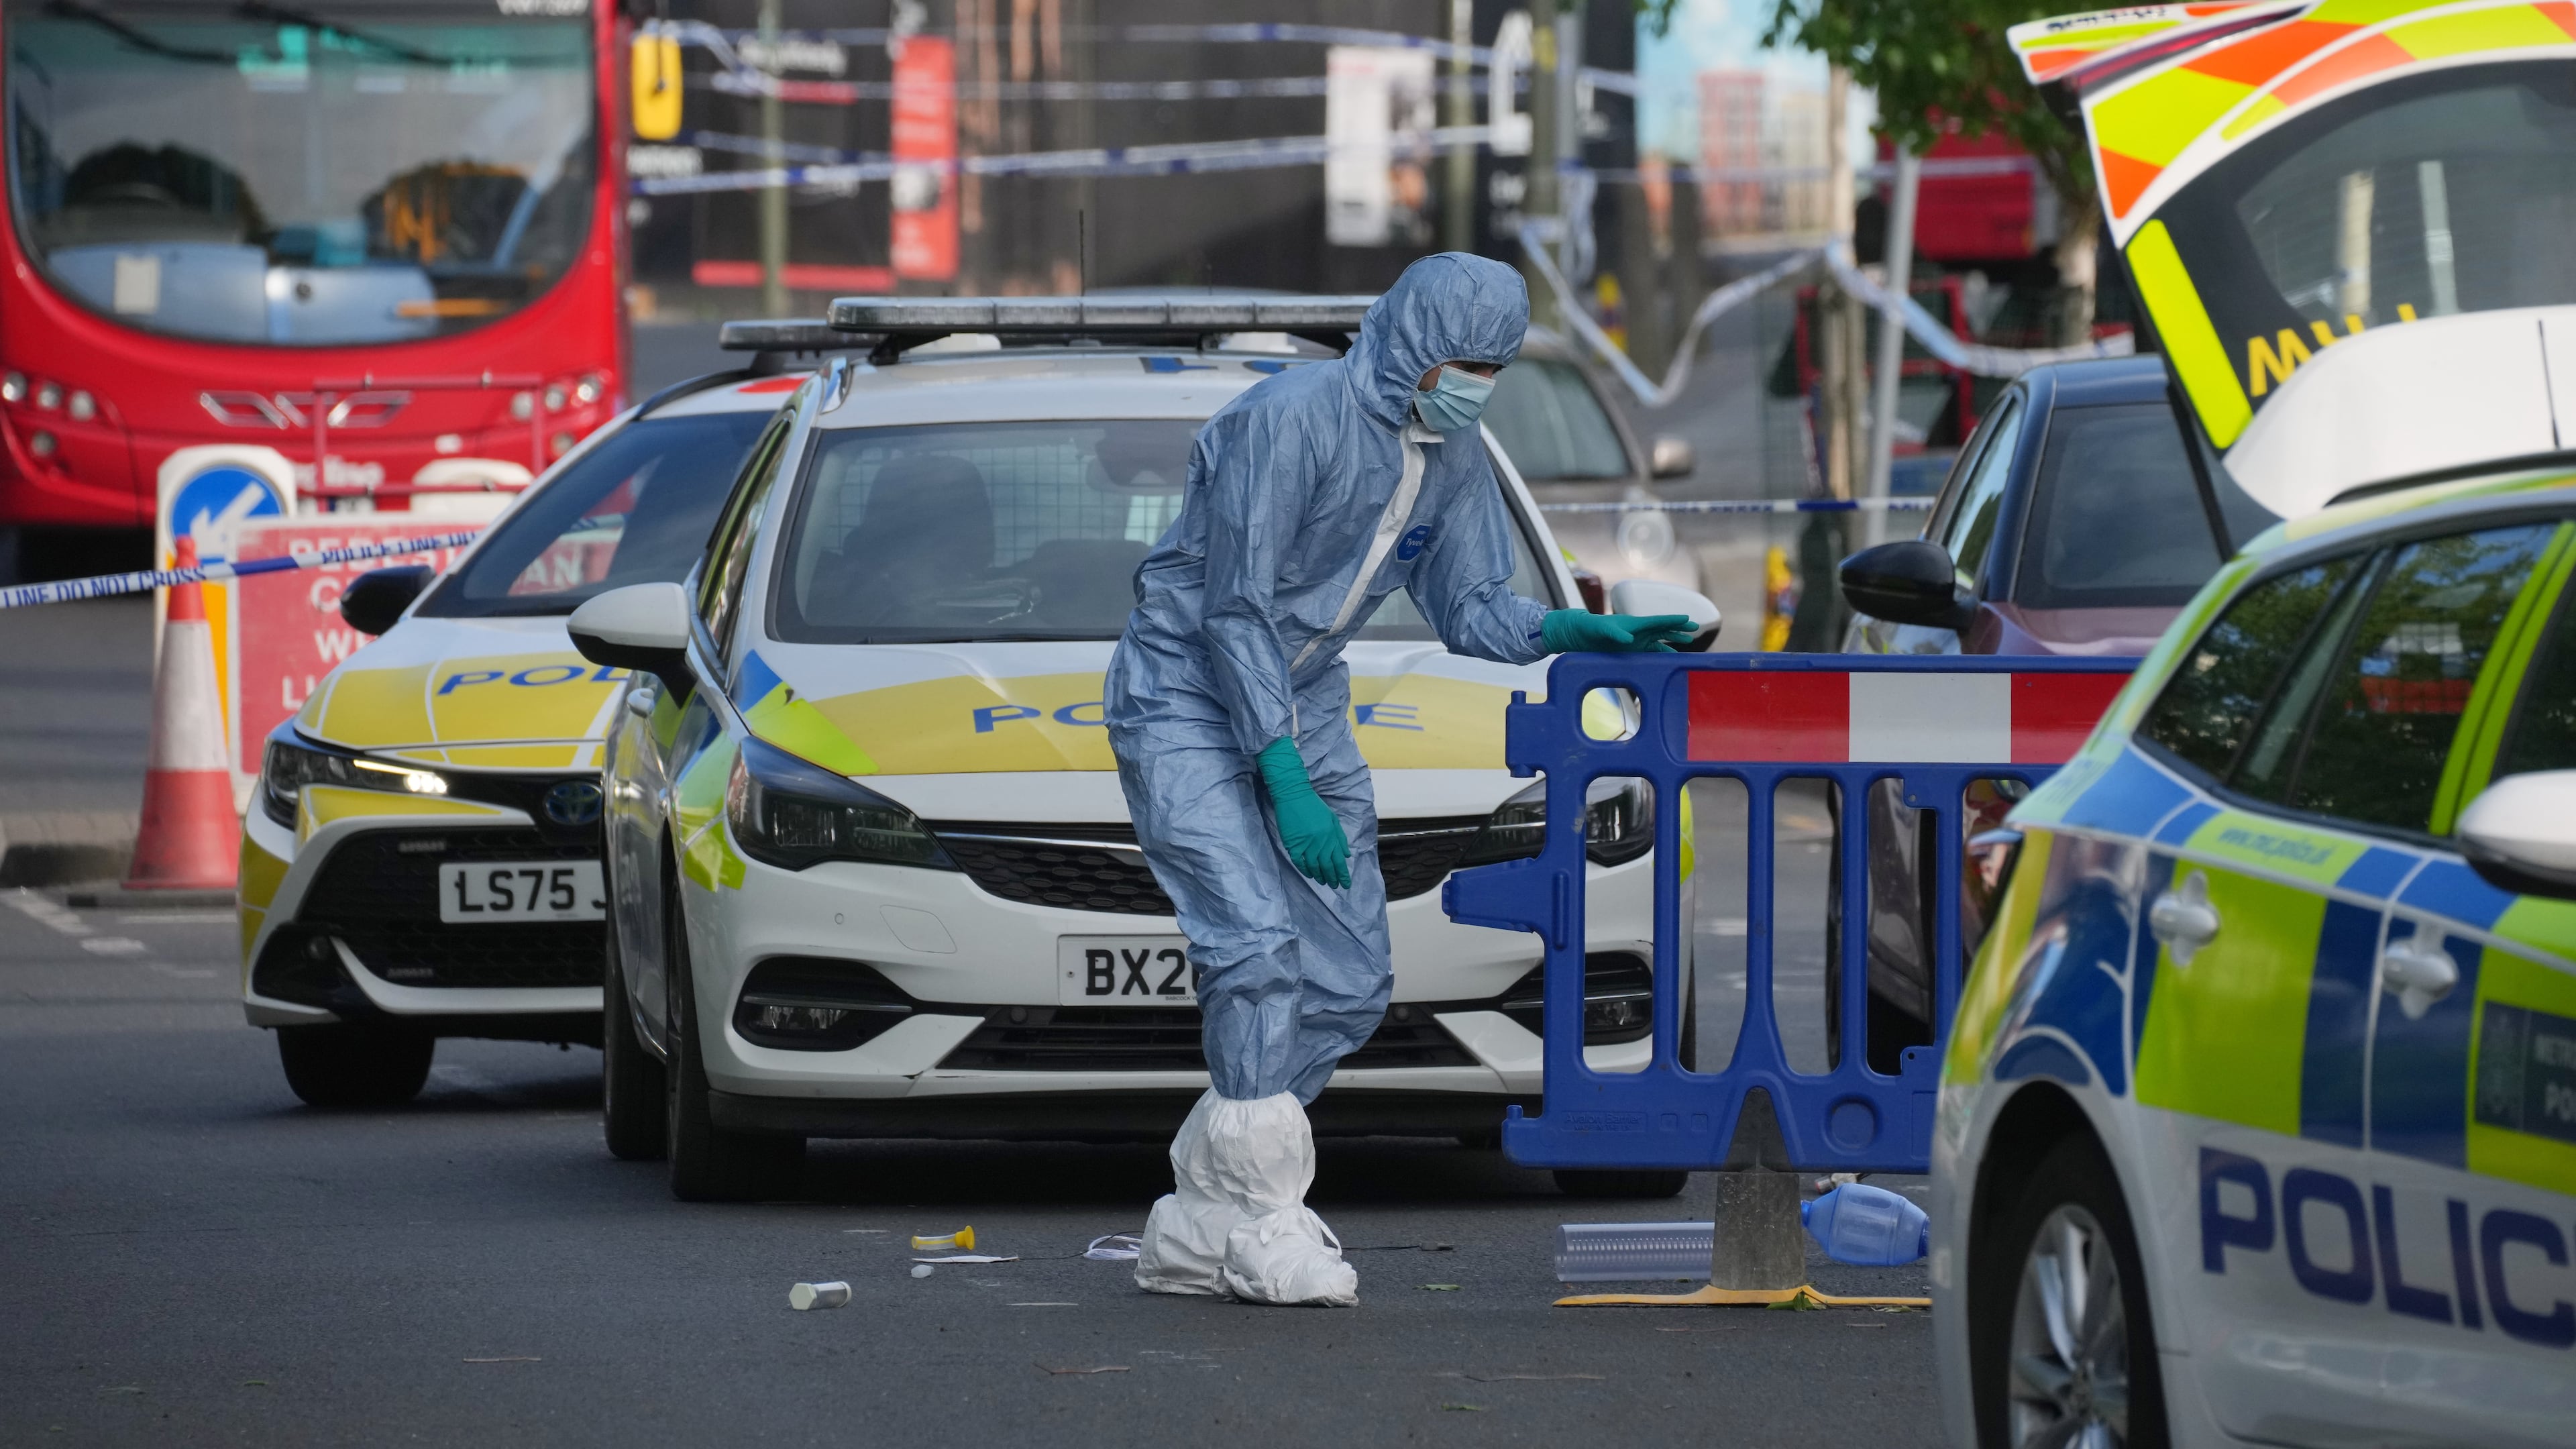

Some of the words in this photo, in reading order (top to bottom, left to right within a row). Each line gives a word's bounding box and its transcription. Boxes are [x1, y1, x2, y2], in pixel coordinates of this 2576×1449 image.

[3, 586, 50, 608] LINE
[55, 582, 85, 602] DO
[91, 574, 130, 596] NOT
[138, 567, 207, 591] CROSS
[458, 869, 574, 912] LS75
[1085, 949, 1199, 996] BX2
[2199, 1146, 2576, 1350] POLIC
